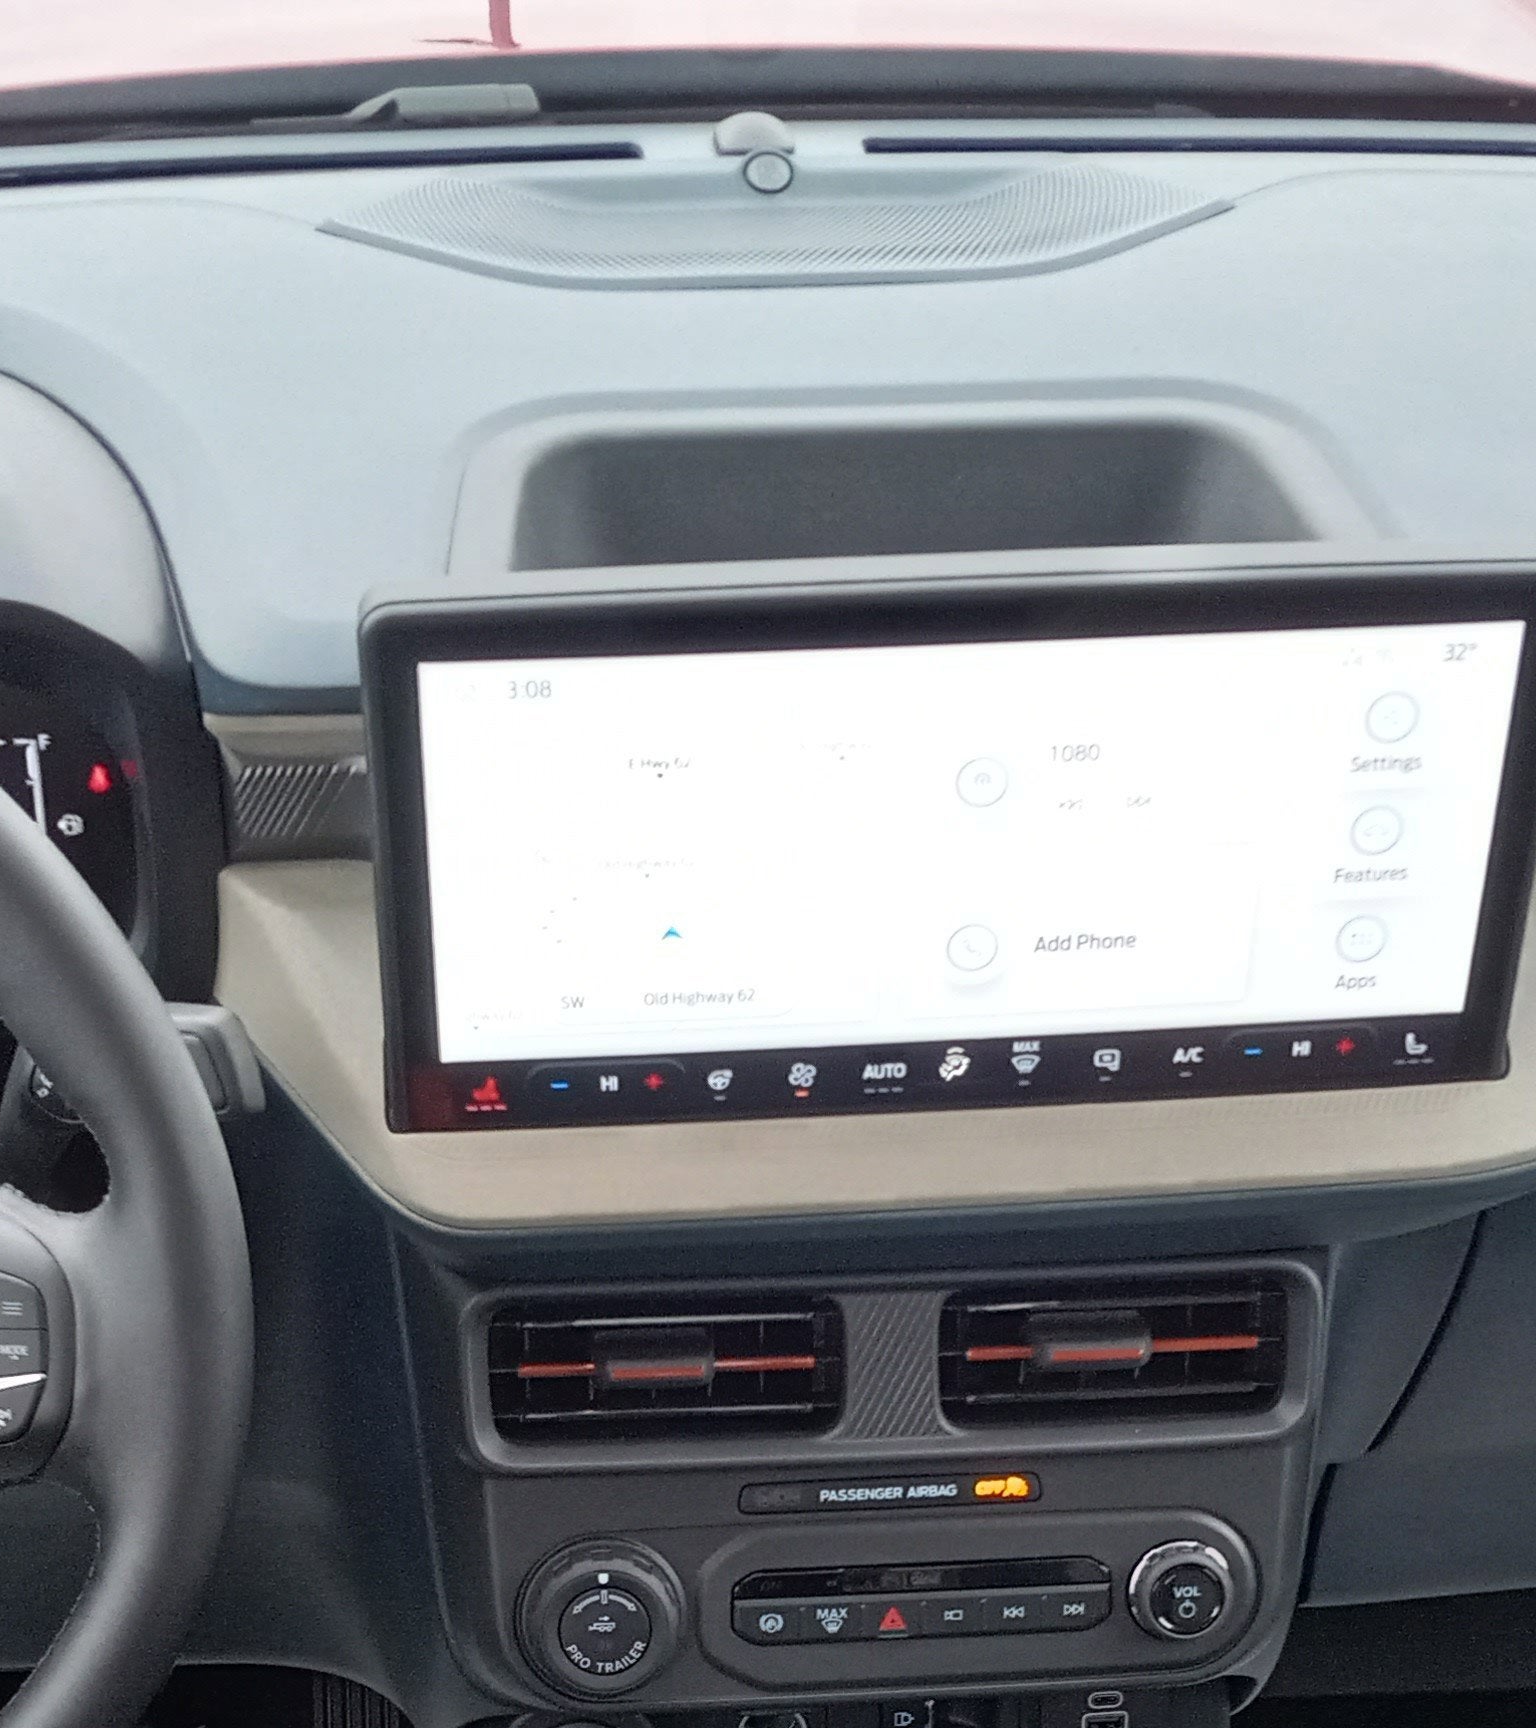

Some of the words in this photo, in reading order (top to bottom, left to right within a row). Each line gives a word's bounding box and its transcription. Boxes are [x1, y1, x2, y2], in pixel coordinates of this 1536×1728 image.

[1442, 642, 1476, 662] 32°
[506, 680, 552, 700] 3:08
[37, 733, 52, 751] F
[1052, 743, 1101, 763] 1080
[1349, 755, 1423, 774] Settings
[1334, 866, 1409, 884] Features
[1033, 935, 1072, 953] Add
[1076, 933, 1137, 951] Phone
[1334, 974, 1377, 991] Apps
[561, 996, 585, 1010] SW
[643, 992, 669, 1006] Old
[672, 991, 734, 1006] Highway
[737, 988, 756, 1002] 62
[1012, 1041, 1041, 1052] MAX
[1172, 1046, 1205, 1064] A/C
[1291, 1040, 1312, 1057] HI
[863, 1062, 907, 1082] AUTO
[599, 1074, 620, 1094] HI
[819, 1487, 904, 1502] PASSENGER
[906, 1484, 958, 1498] AIRBAG
[1173, 1585, 1203, 1599] VOL
[815, 1606, 848, 1620] MAX
[566, 1643, 592, 1669] PRO
[596, 1640, 648, 1674] TRAILER
